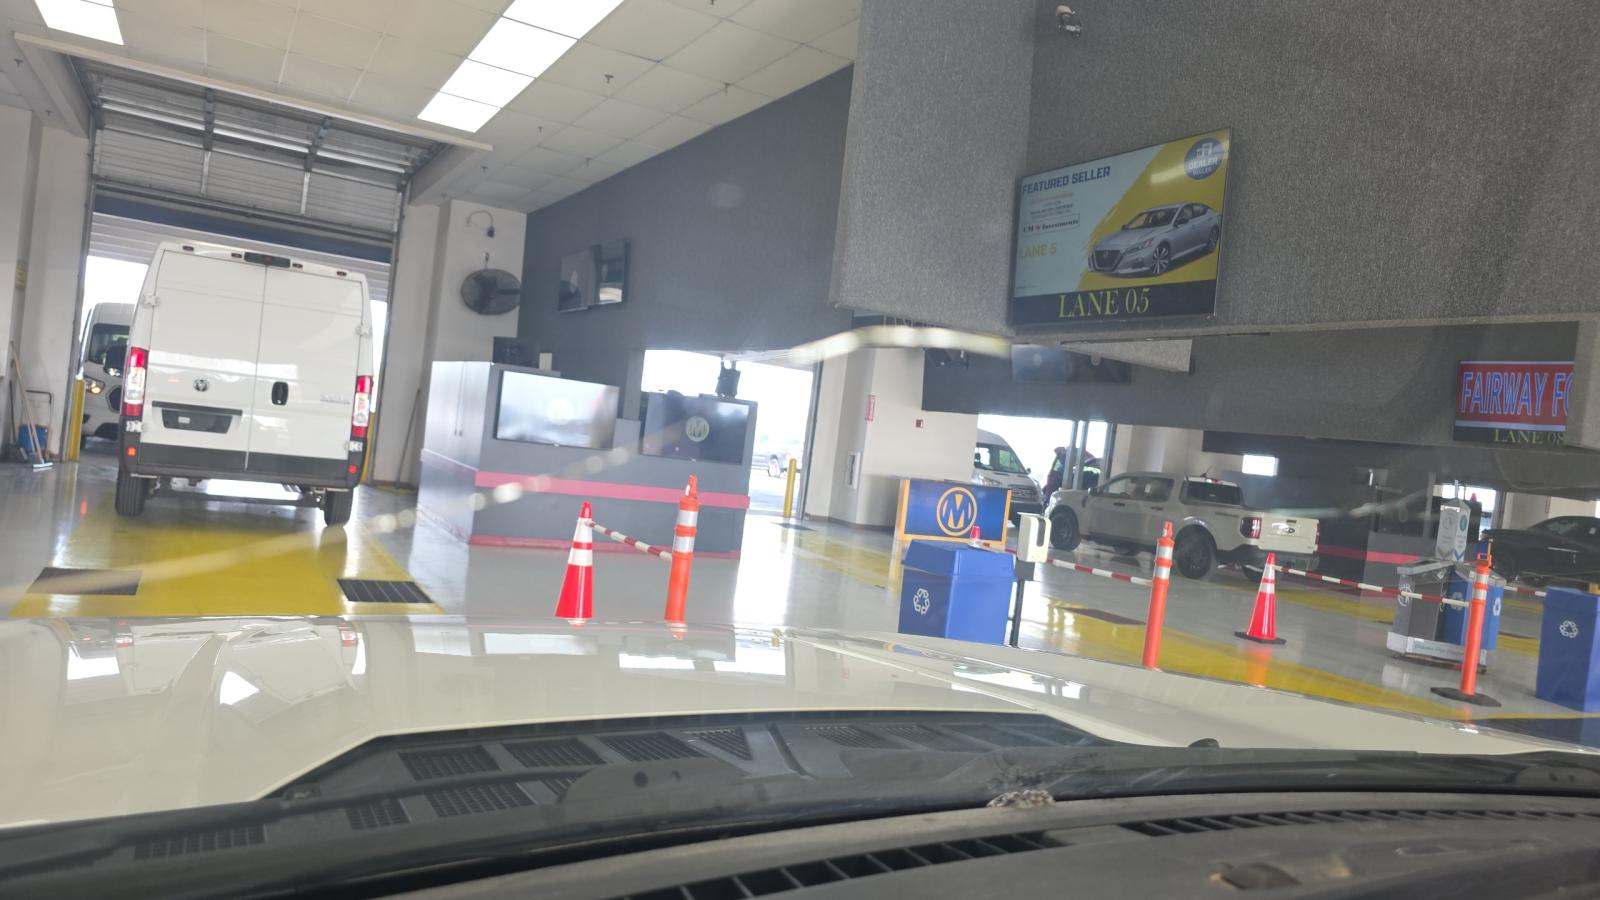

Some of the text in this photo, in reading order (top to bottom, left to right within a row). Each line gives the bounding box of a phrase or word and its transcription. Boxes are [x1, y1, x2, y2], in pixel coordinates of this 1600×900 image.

[1022, 166, 1111, 195] FEATURED SELLER
[1059, 287, 1151, 318] LANE 05
[1460, 371, 1548, 416] FAIRWAY
[1493, 429, 1545, 445] LANE
